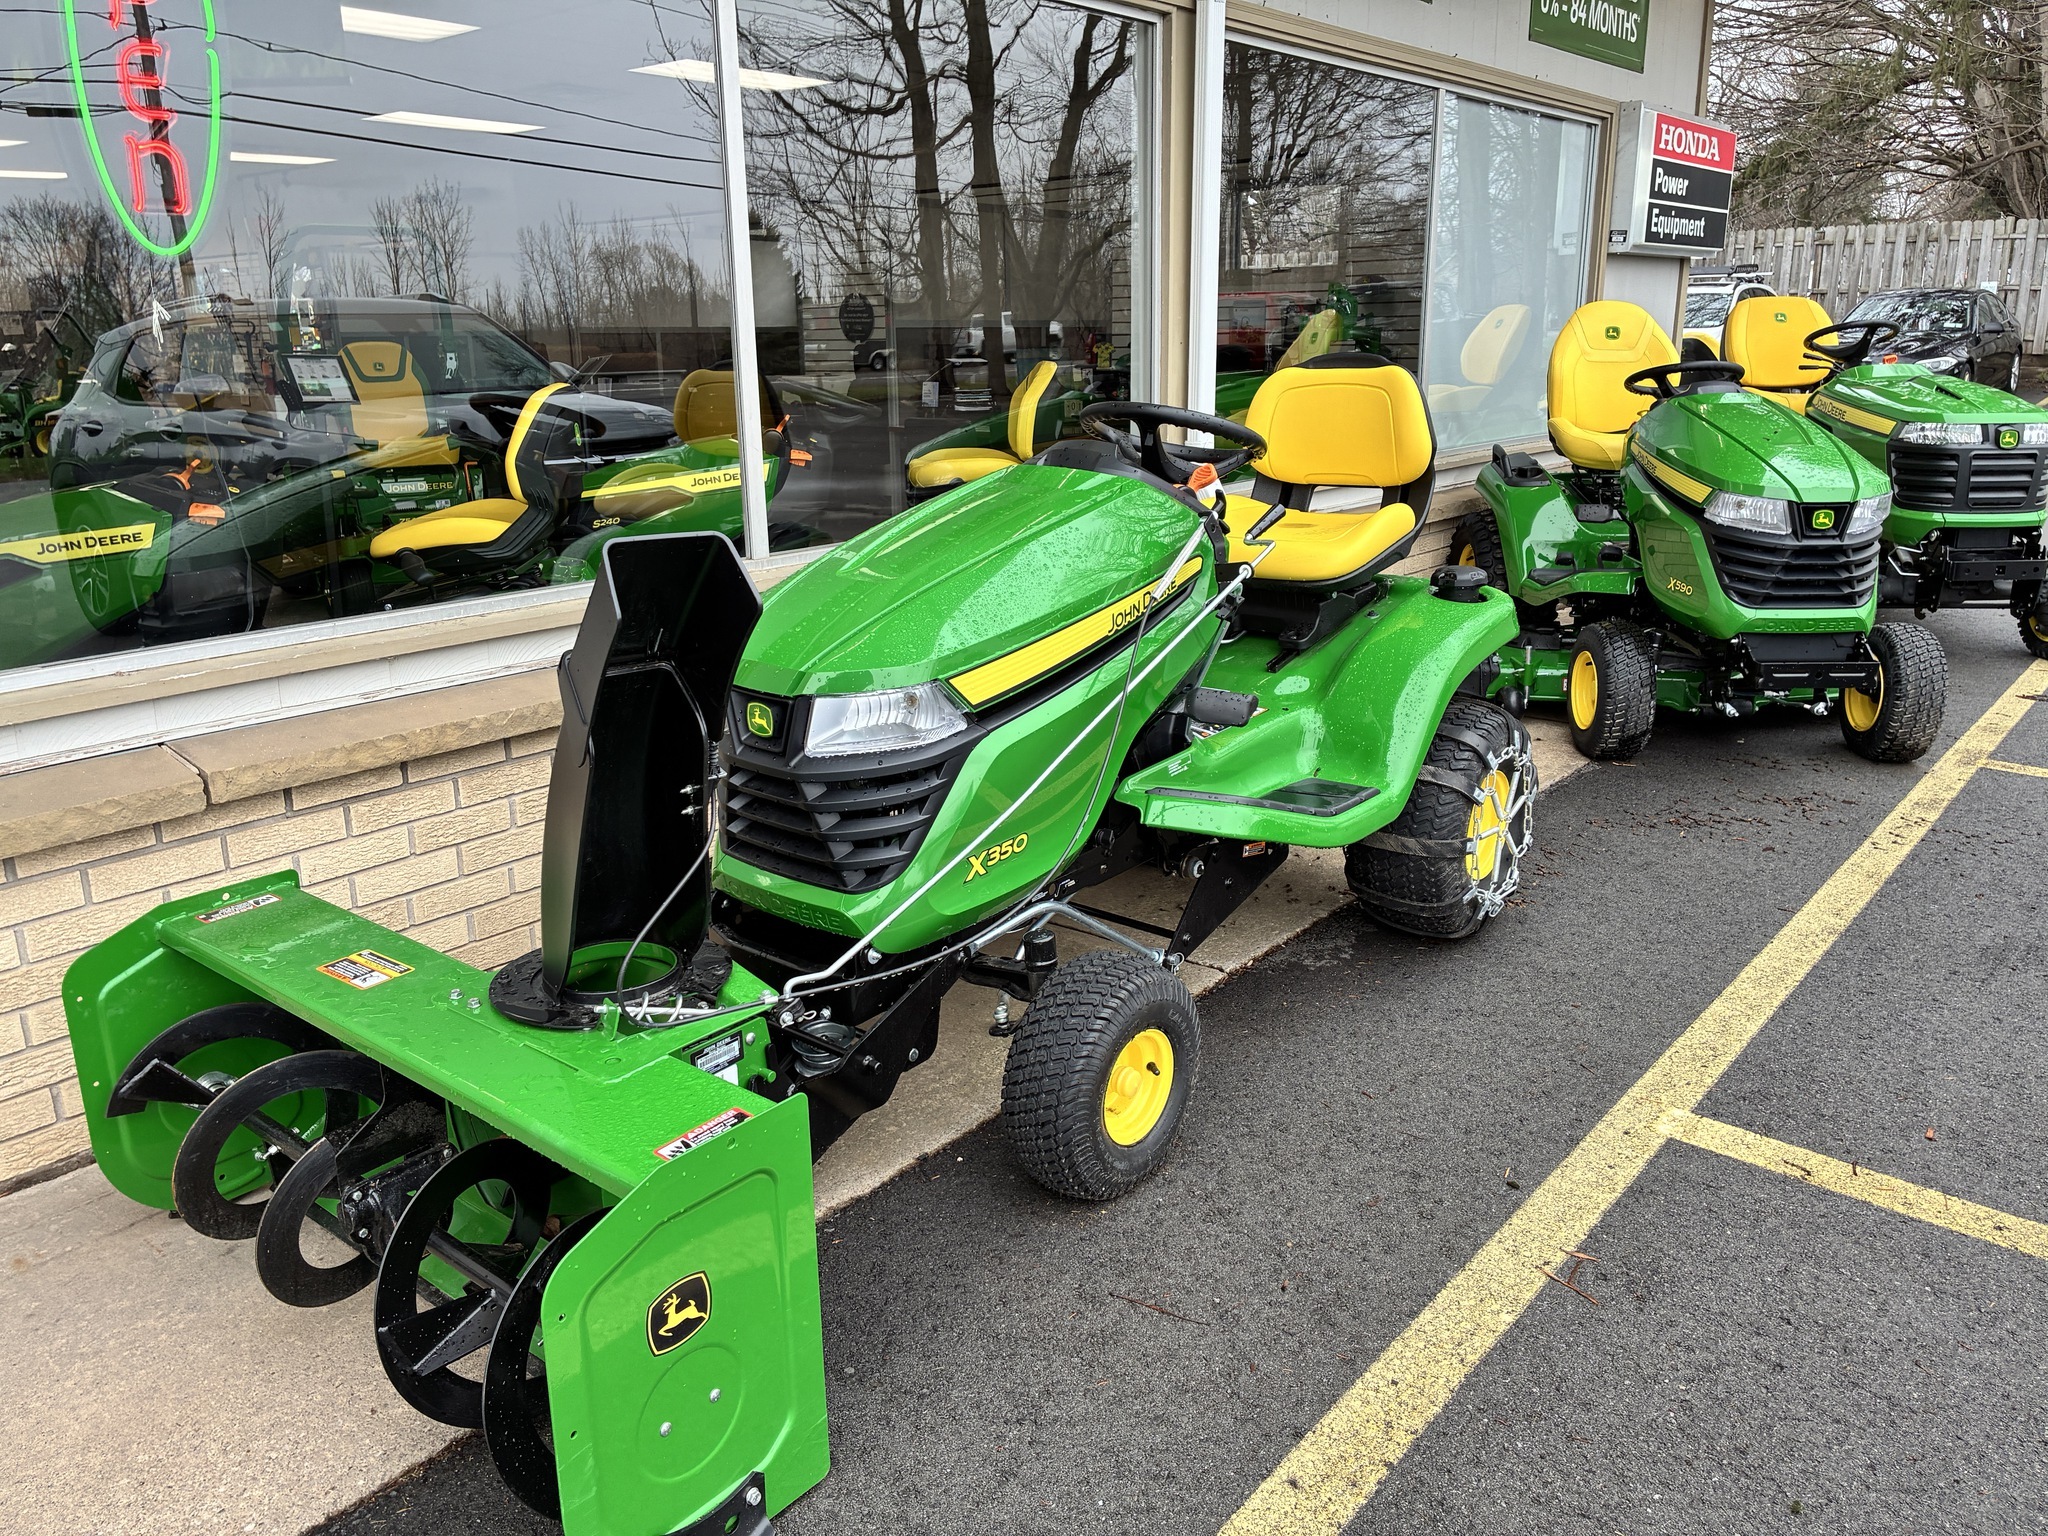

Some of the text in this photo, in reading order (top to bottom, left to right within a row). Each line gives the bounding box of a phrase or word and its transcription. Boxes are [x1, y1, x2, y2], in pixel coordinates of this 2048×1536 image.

[1570, 0, 1587, 27] 84
[1659, 123, 1720, 162] HONDA
[1654, 166, 1689, 197] Power
[1650, 207, 1705, 240] Equipment
[1814, 397, 1847, 421] JOHN DEERE
[386, 481, 454, 494] JOHN DEERE
[690, 474, 721, 488] JOHN
[592, 516, 621, 529] S240
[36, 531, 144, 556] JOHN DEERE
[1666, 577, 1693, 596] X590
[1107, 600, 1141, 634] JOHN
[1753, 620, 1857, 633] JOHN DEERE
[963, 832, 1029, 885] X350
